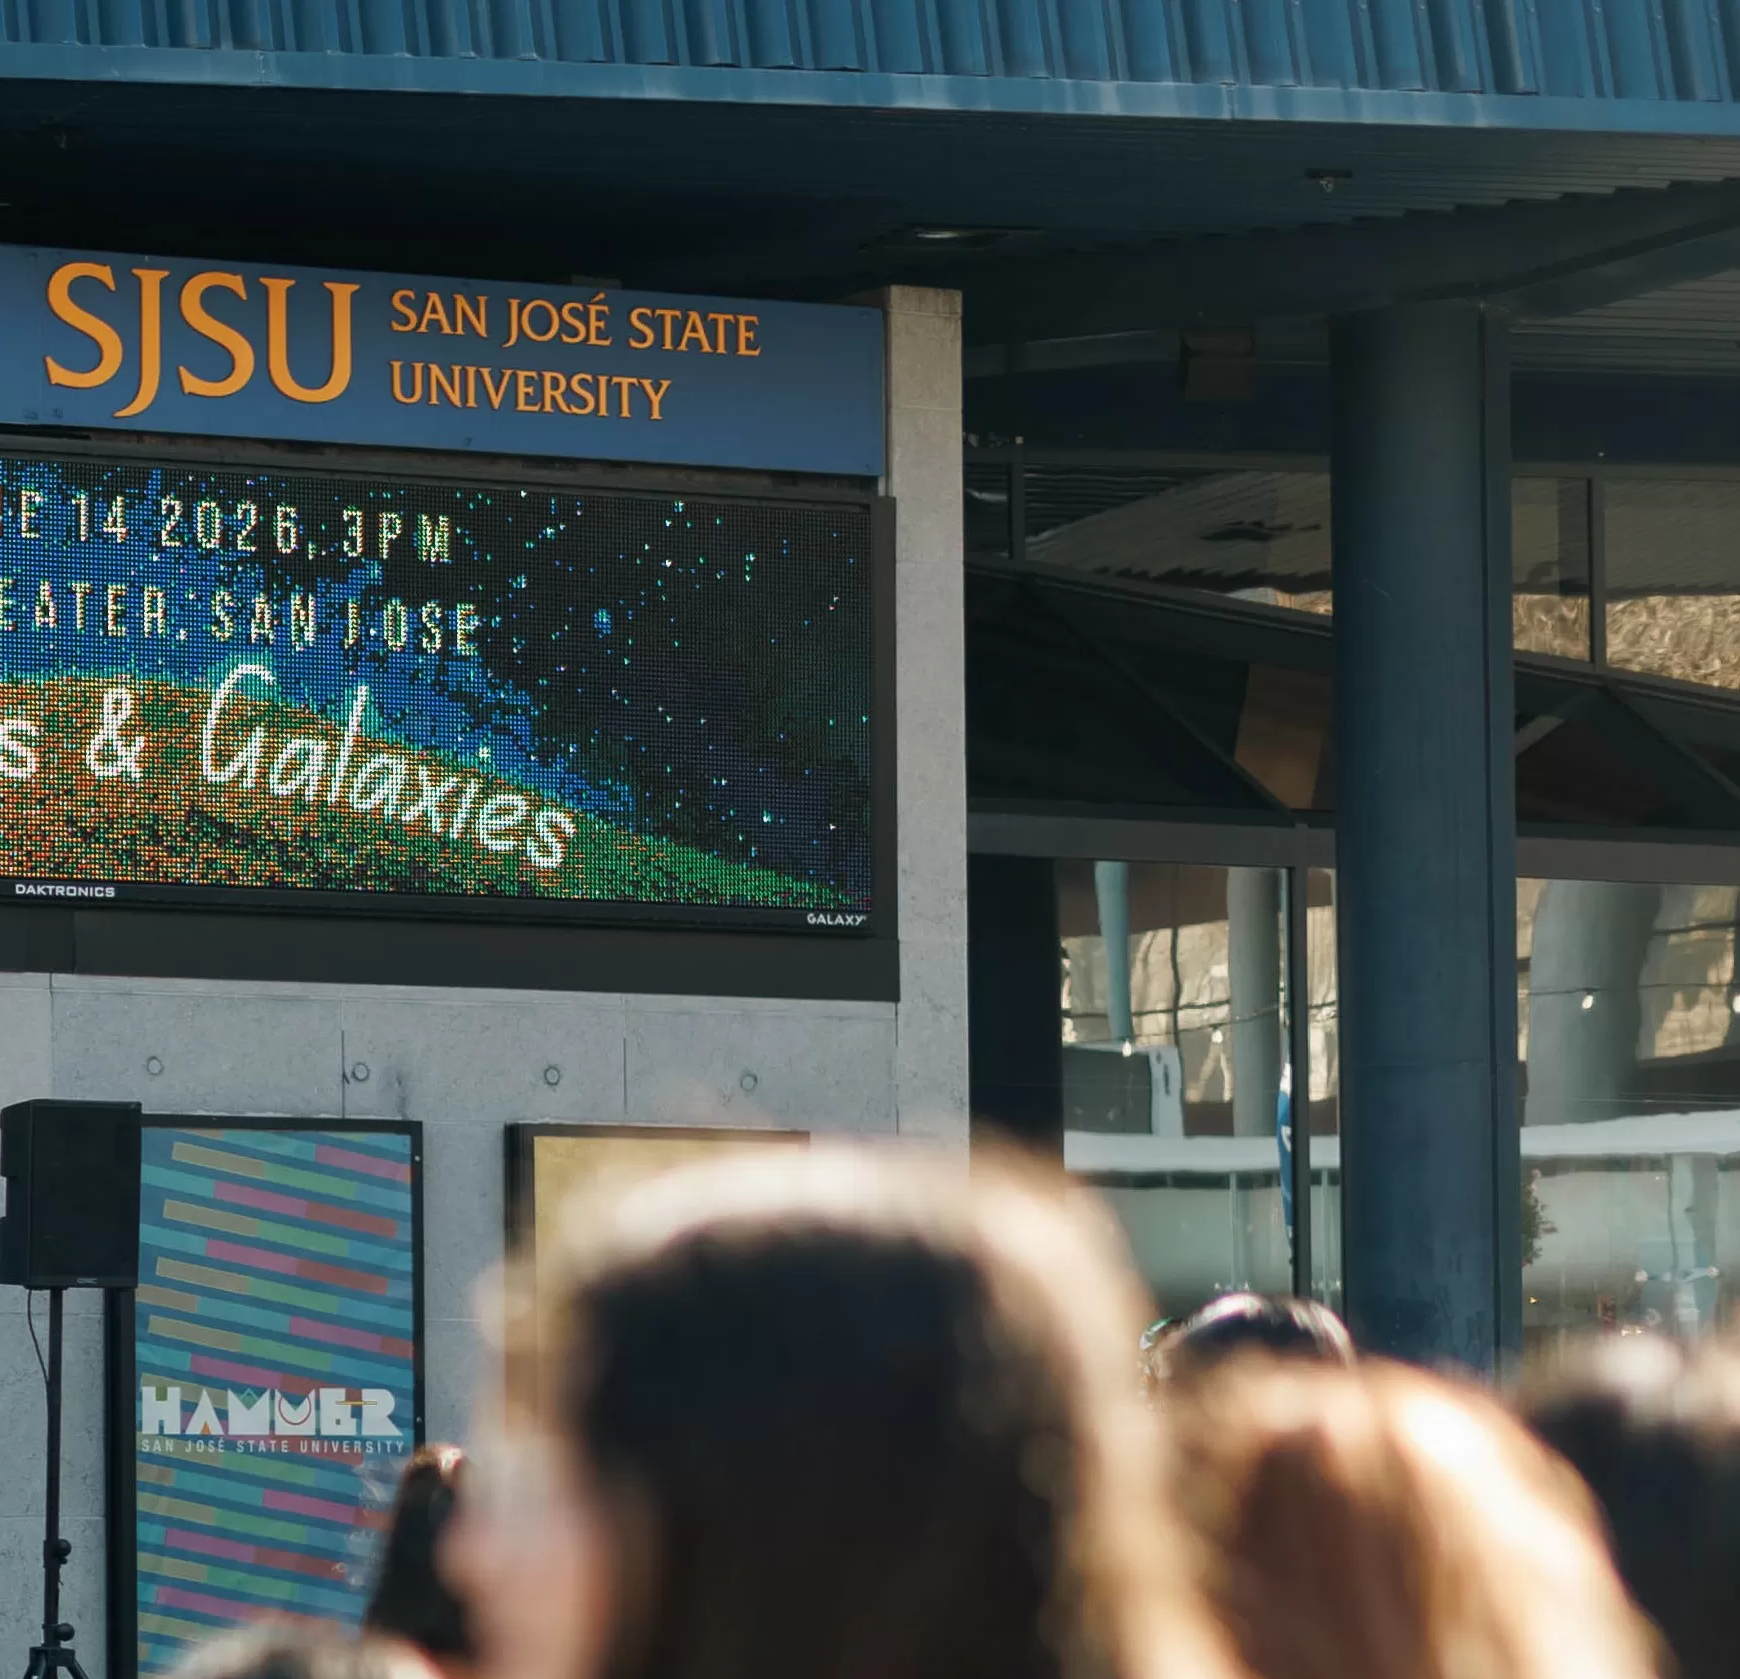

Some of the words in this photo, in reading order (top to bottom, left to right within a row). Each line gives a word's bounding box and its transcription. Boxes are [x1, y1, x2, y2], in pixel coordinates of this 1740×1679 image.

[44, 261, 360, 417] SJSU
[390, 289, 488, 338] SAN
[503, 292, 612, 347] JOSÉ
[630, 308, 761, 357] STATE
[390, 360, 672, 421] UNIVERSITY
[72, 494, 128, 543] 14
[161, 496, 317, 560] 2026,
[343, 507, 451, 562] 3PM
[213, 590, 316, 651] SAN
[344, 598, 479, 656] JOSE
[85, 687, 145, 780] &
[203, 663, 576, 868] Galaxies
[15, 883, 116, 898] DAKTRONICS
[807, 912, 864, 926] GALAXY
[141, 1386, 403, 1436] HAMMER
[141, 1440, 173, 1453] SAN
[185, 1437, 224, 1453] JOSÉ
[236, 1440, 289, 1453] STATE
[300, 1440, 404, 1454] UNIVERSITY
